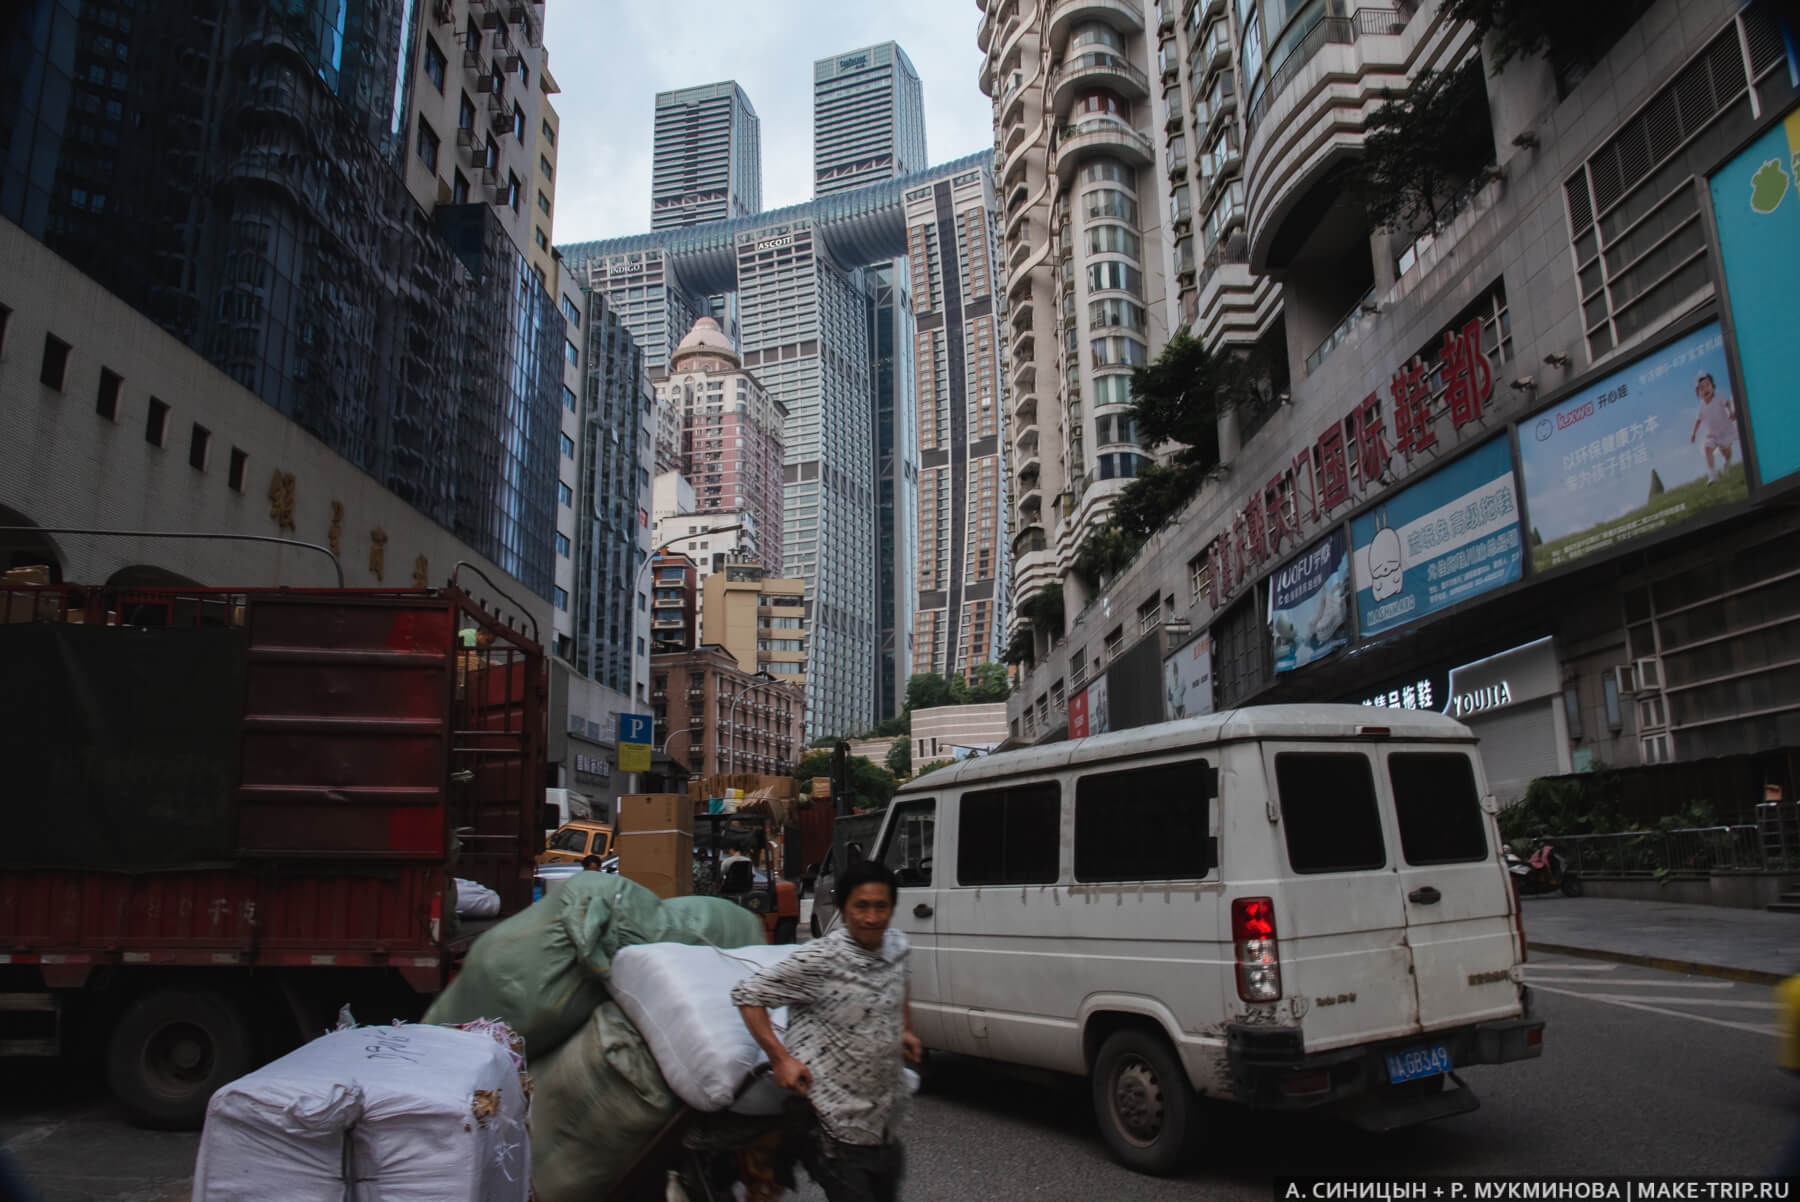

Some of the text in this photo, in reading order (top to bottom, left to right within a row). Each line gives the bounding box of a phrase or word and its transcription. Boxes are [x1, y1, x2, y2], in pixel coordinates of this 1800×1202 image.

[757, 235, 792, 250] ASCOTT
[610, 263, 641, 275] INDIGO
[1453, 680, 1513, 717] YOUJIA
[629, 718, 644, 739] P
